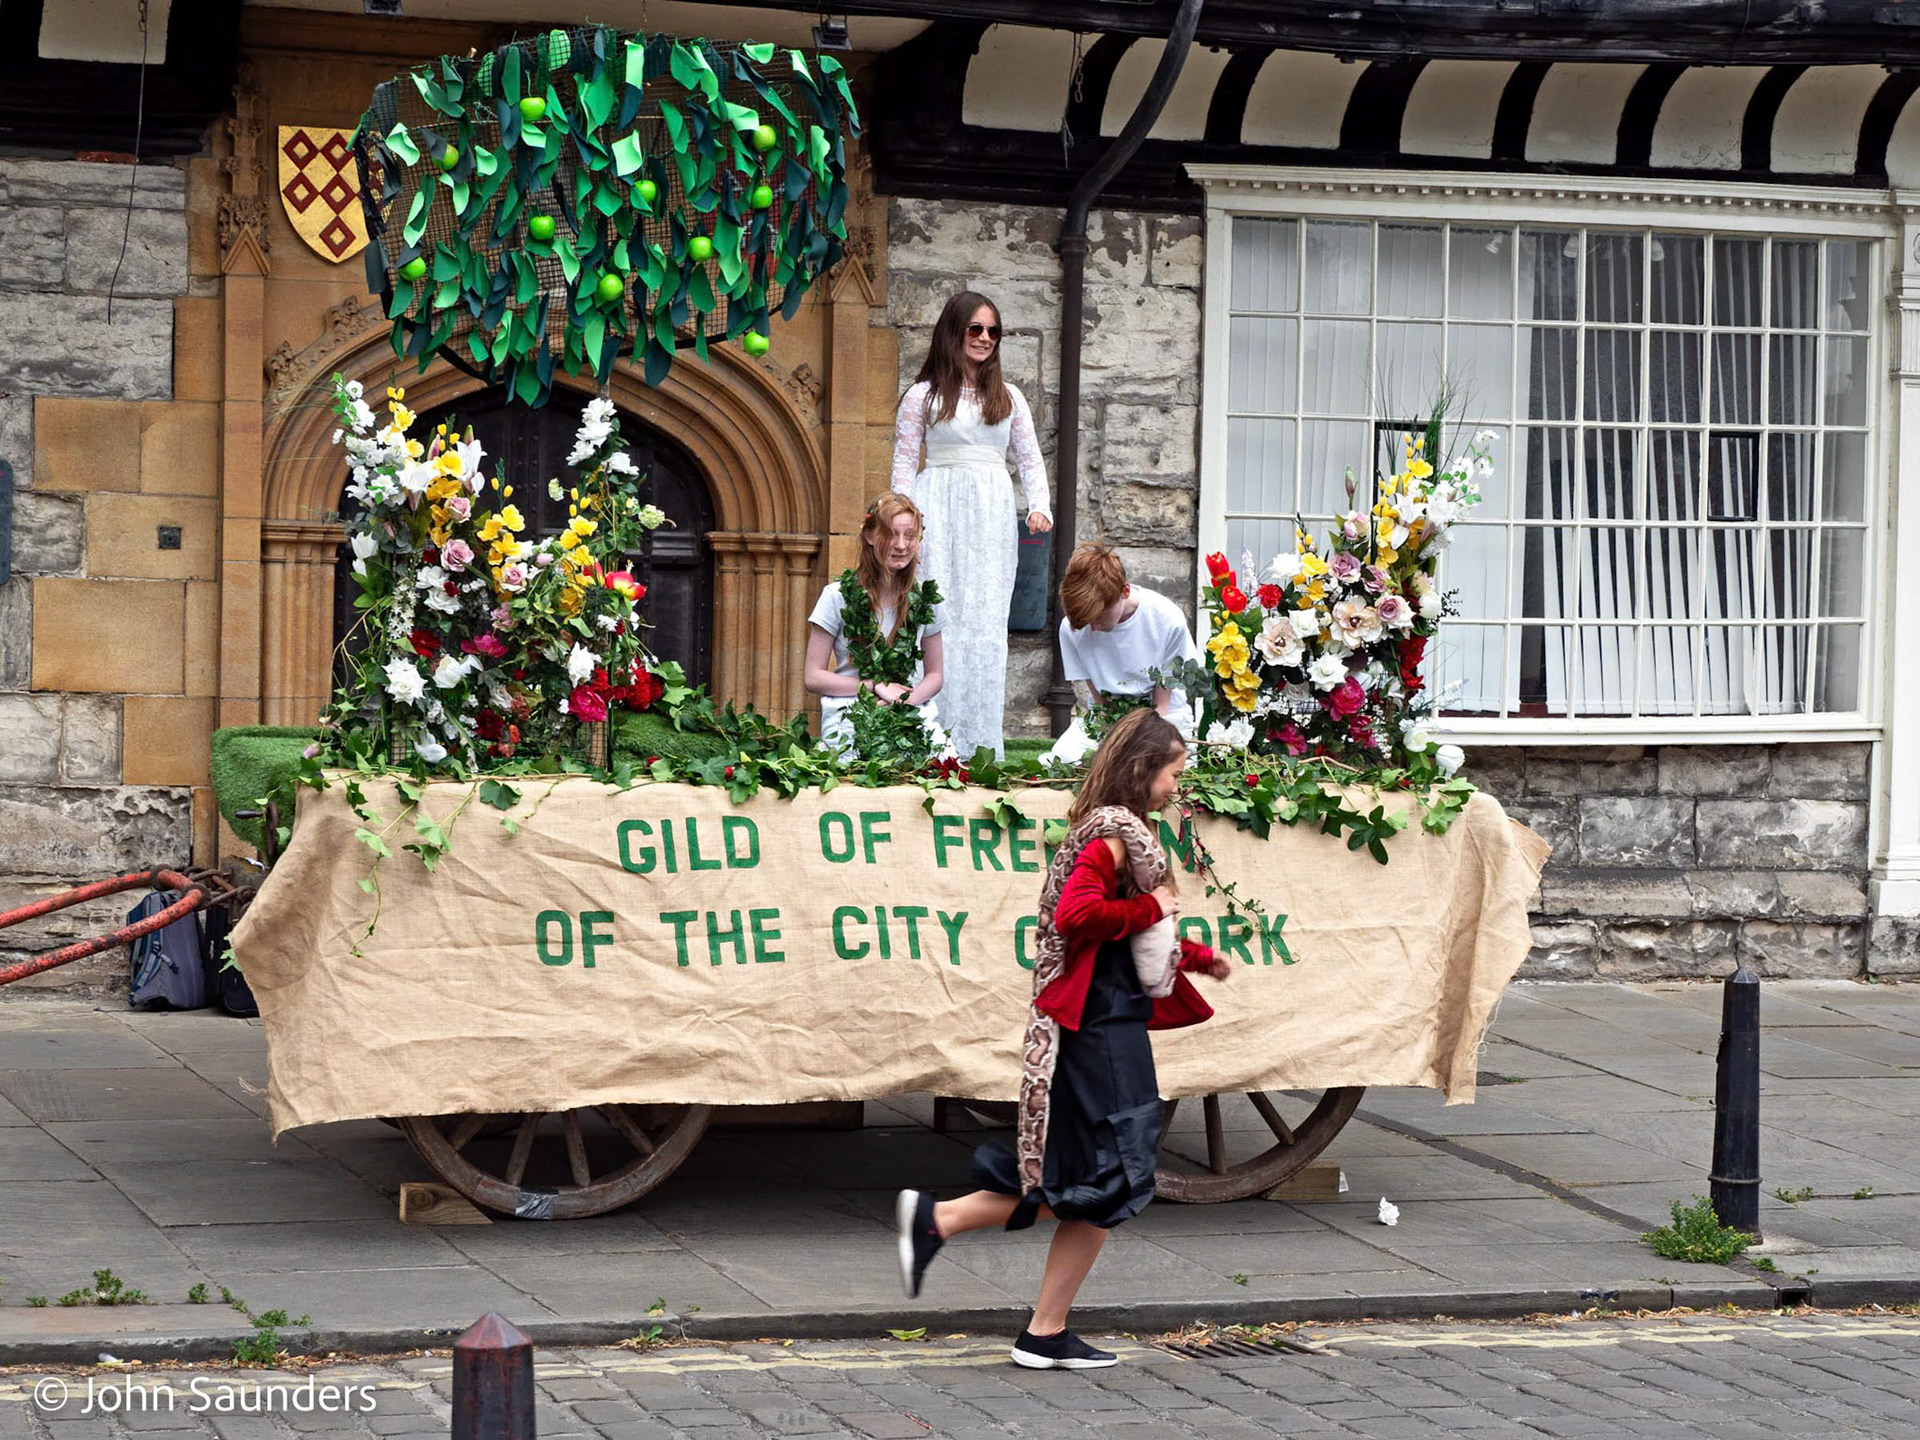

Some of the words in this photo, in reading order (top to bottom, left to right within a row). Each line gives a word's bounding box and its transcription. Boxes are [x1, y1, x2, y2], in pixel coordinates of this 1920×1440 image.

[617, 815, 761, 874] GILD
[820, 811, 891, 864] OF
[933, 814, 1196, 873] FREN
[535, 910, 615, 968] OF
[659, 908, 785, 967] THE
[832, 905, 969, 965] CITY
[1177, 914, 1295, 966] ORK
